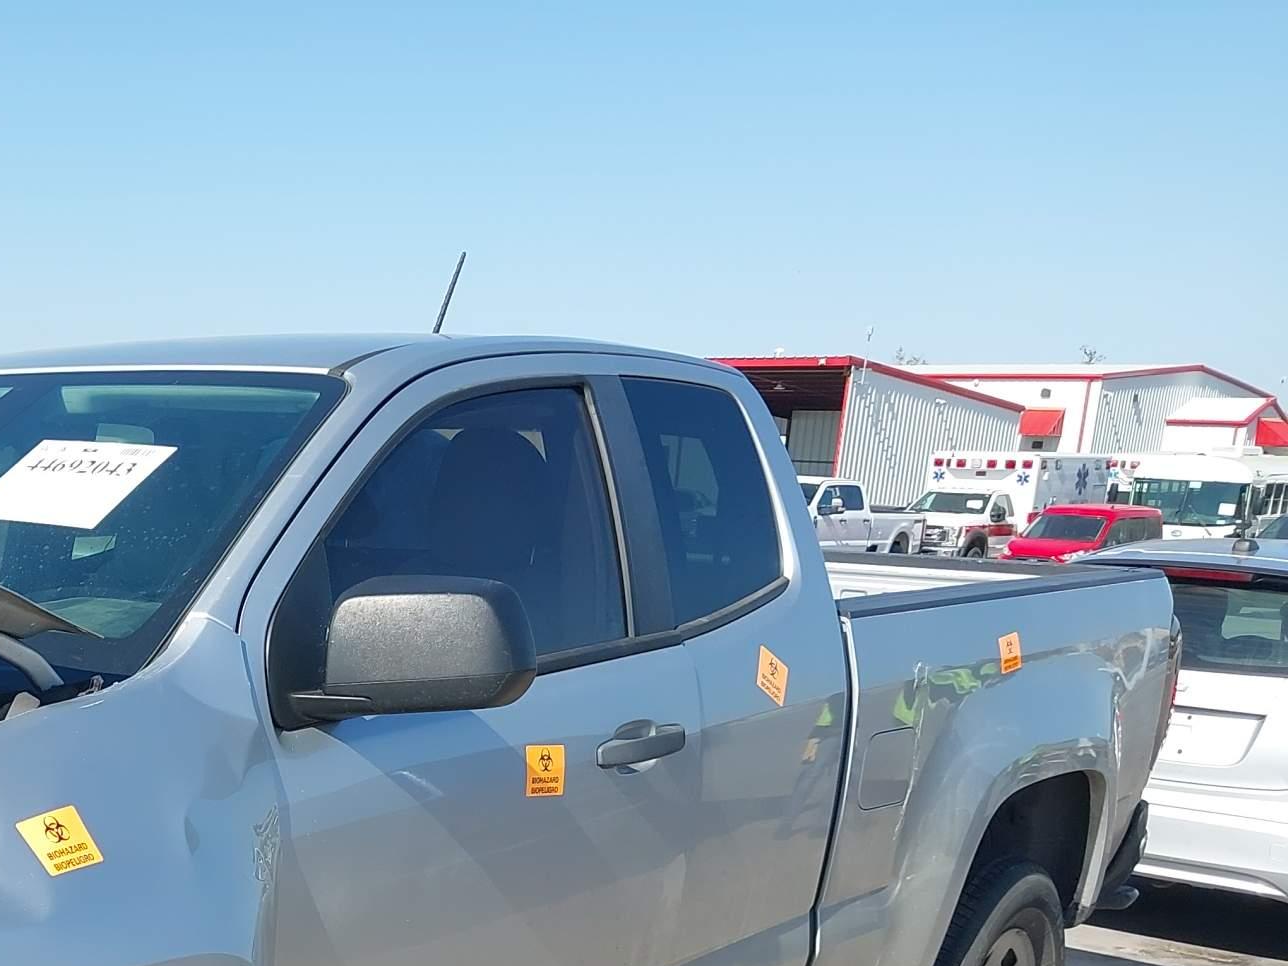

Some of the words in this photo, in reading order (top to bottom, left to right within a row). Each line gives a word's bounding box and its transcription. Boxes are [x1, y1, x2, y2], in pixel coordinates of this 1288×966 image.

[26, 457, 137, 476] 44692043
[532, 776, 559, 784] BIOHAZARD
[47, 843, 88, 860] BIOHAZARD
[54, 854, 94, 871] BIOPELIGRO
